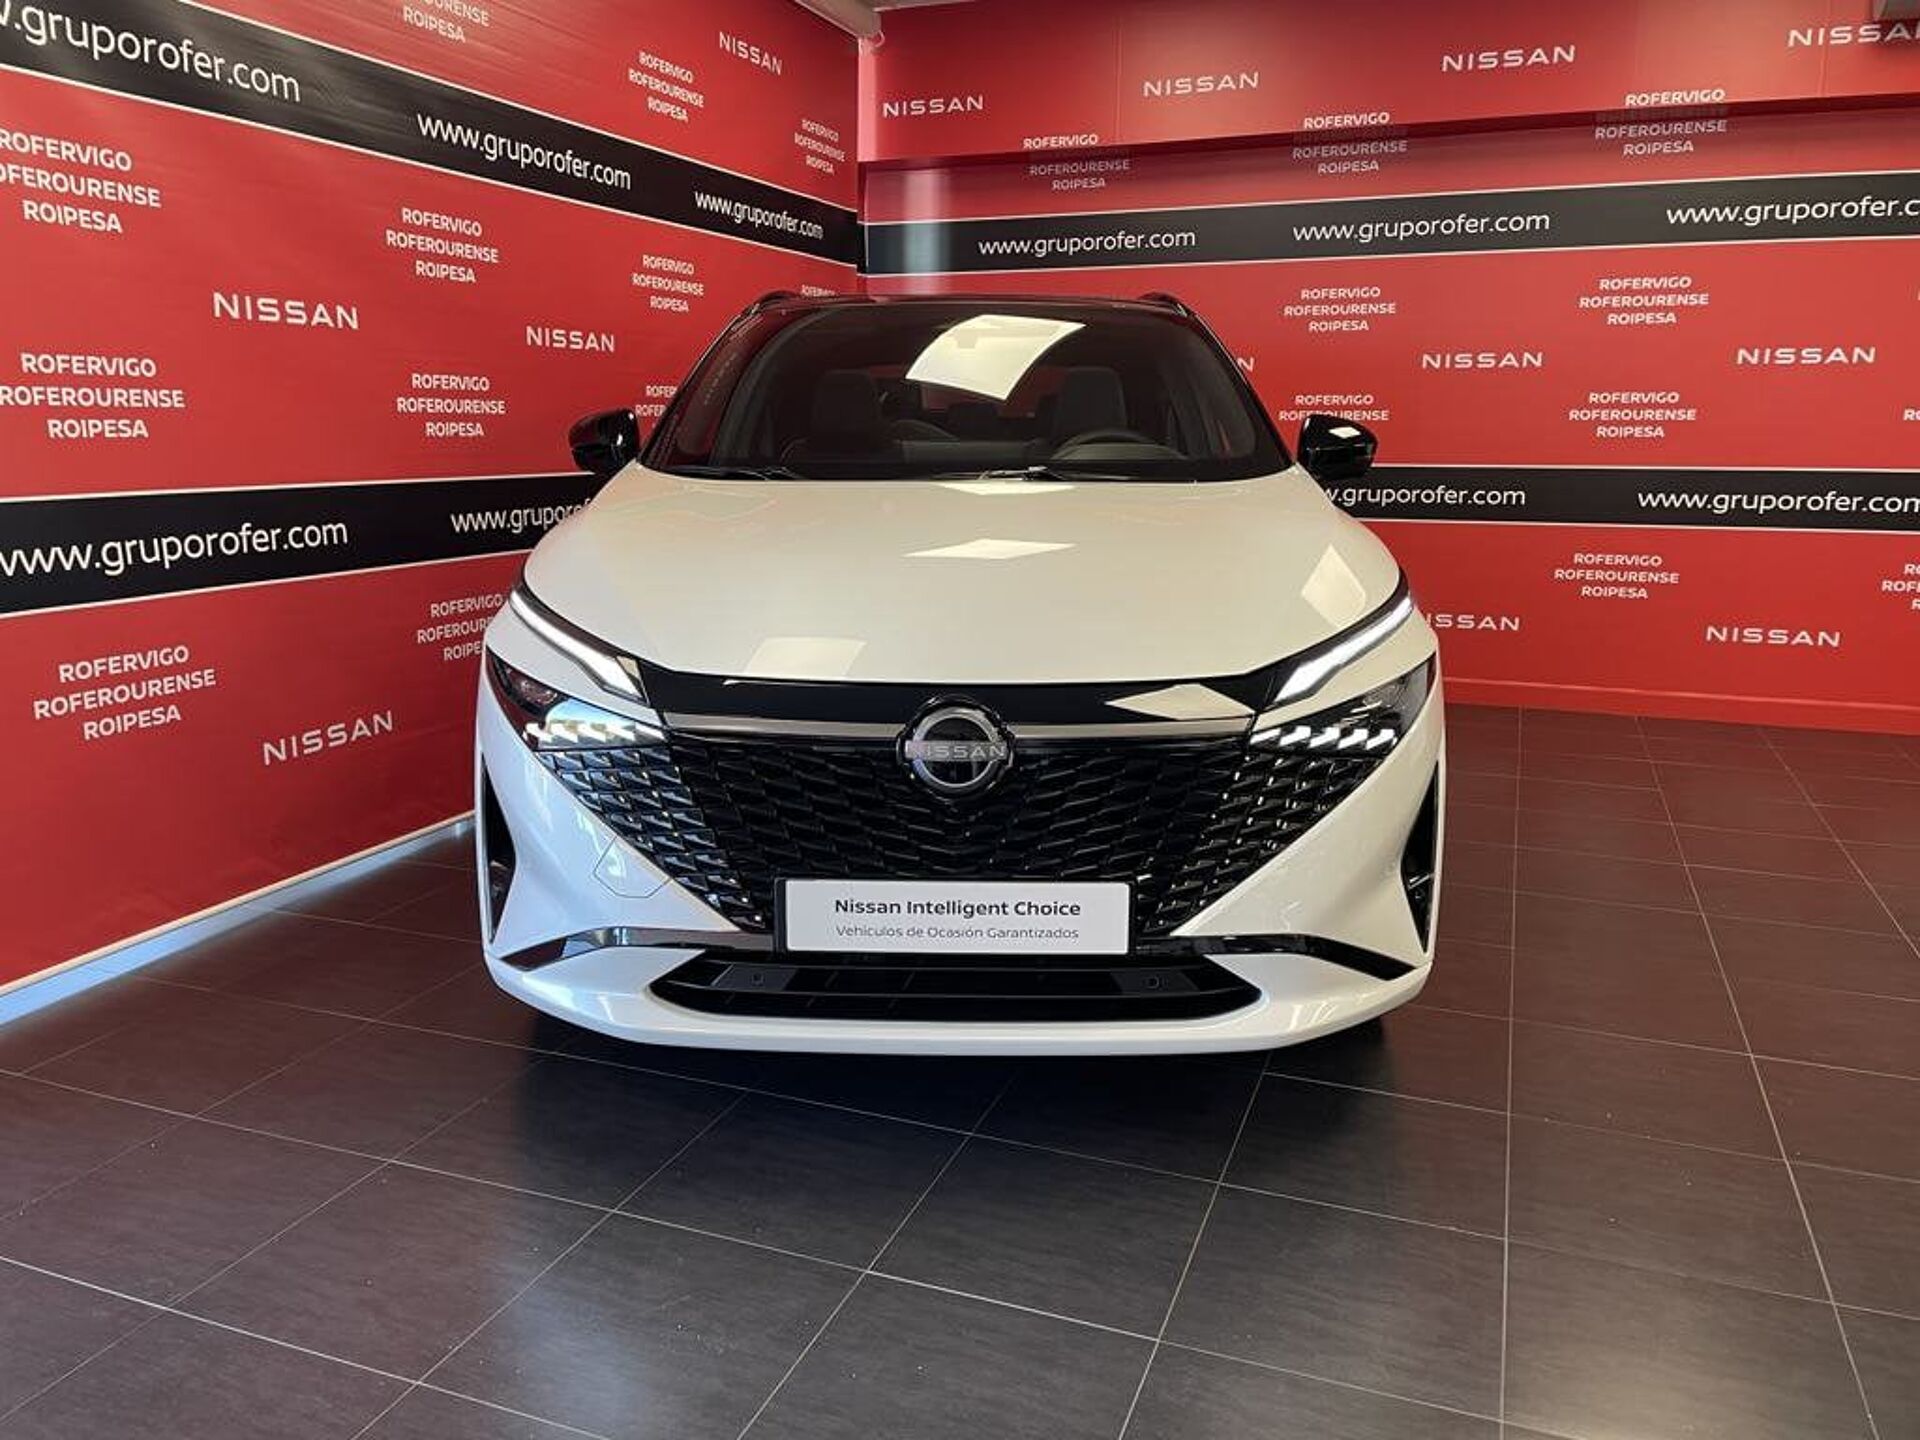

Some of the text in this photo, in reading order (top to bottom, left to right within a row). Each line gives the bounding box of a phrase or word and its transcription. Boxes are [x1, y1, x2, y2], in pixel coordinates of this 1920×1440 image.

[403, 5, 466, 43] ROIPESA
[719, 31, 782, 75] NISSAN
[1441, 45, 1576, 72] NISSAN
[639, 51, 694, 83] ROFERVIGO
[628, 69, 704, 107] ROFEROURENSE
[1143, 72, 1259, 97] NISSAN
[883, 96, 984, 117] NISSAN
[1625, 89, 1725, 107] ROFERVIGO
[648, 97, 689, 123] ROIPESA
[1304, 111, 1390, 129] ROFERVIGO
[1595, 120, 1727, 139] ROFEROURENSE
[0, 128, 132, 171] ROFERVIGO
[417, 113, 631, 190] www.gruporofer.com
[1023, 134, 1099, 149] ROFERVIGO
[1293, 140, 1408, 159] ROFEROURENSE
[1623, 140, 1694, 156] ROIPESA
[1030, 160, 1130, 176] ROFEROURENSE
[1318, 160, 1379, 174] ROIPESA
[1052, 178, 1106, 190] ROIPESA
[23, 200, 122, 233] ROIPESA
[695, 190, 823, 239] www.gruporofer.com
[1666, 195, 1920, 226] www.gruporofer.c
[402, 207, 482, 237] ROFERVIGO
[1293, 213, 1550, 244] www.gruporofer.com
[386, 230, 499, 263] ROFEROURENSE
[978, 228, 1195, 258] www.gruporofer.com
[416, 260, 476, 284] ROIPESA
[642, 255, 694, 275] ROFERVIGO
[632, 274, 704, 297] ROFEROURENSE
[1301, 286, 1381, 300] ROFERVIGO
[1599, 276, 1692, 291] ROFERVIGO
[650, 296, 689, 312] ROIPESA
[1284, 303, 1396, 317] ROFEROURENSE
[1579, 293, 1709, 308] ROFEROURENSE
[213, 292, 359, 330] NISSAN
[1607, 312, 1677, 325] ROIPESA
[1308, 320, 1369, 333] ROIPESA
[526, 326, 614, 353] NISSAN
[1422, 352, 1543, 369] NISSAN
[1737, 346, 1876, 364] NISSAN
[21, 353, 157, 378] ROFERVIGO
[412, 373, 490, 391] ROFERVIGO
[0, 385, 185, 408] ROFEROURENSE
[397, 397, 506, 415] ROFEROURENSE
[1295, 394, 1374, 406] ROFERVIGO
[1588, 391, 1680, 404] ROFERVIGO
[1569, 409, 1696, 421] ROFEROURENSE
[47, 419, 149, 438] ROIPESA
[425, 423, 484, 437] ROIPESA
[1596, 425, 1665, 438] ROIPESA
[1573, 553, 1662, 566] ROFERVIGO
[1554, 569, 1679, 584] ROFEROURENSE
[1581, 585, 1648, 598] ROIPESA
[431, 594, 504, 617] ROFERVIGO
[1706, 625, 1840, 647] NISSAN
[59, 645, 189, 683] ROFERVIGO
[33, 669, 216, 720] ROFEROURENSE
[83, 706, 181, 741] ROIPESA
[263, 711, 394, 765] NISSAN
[835, 899, 1081, 919] Nissan Intelligent Choice
[907, 925, 923, 938] de
[927, 926, 983, 938] Ocasión
[987, 927, 1079, 939] Garantizados
